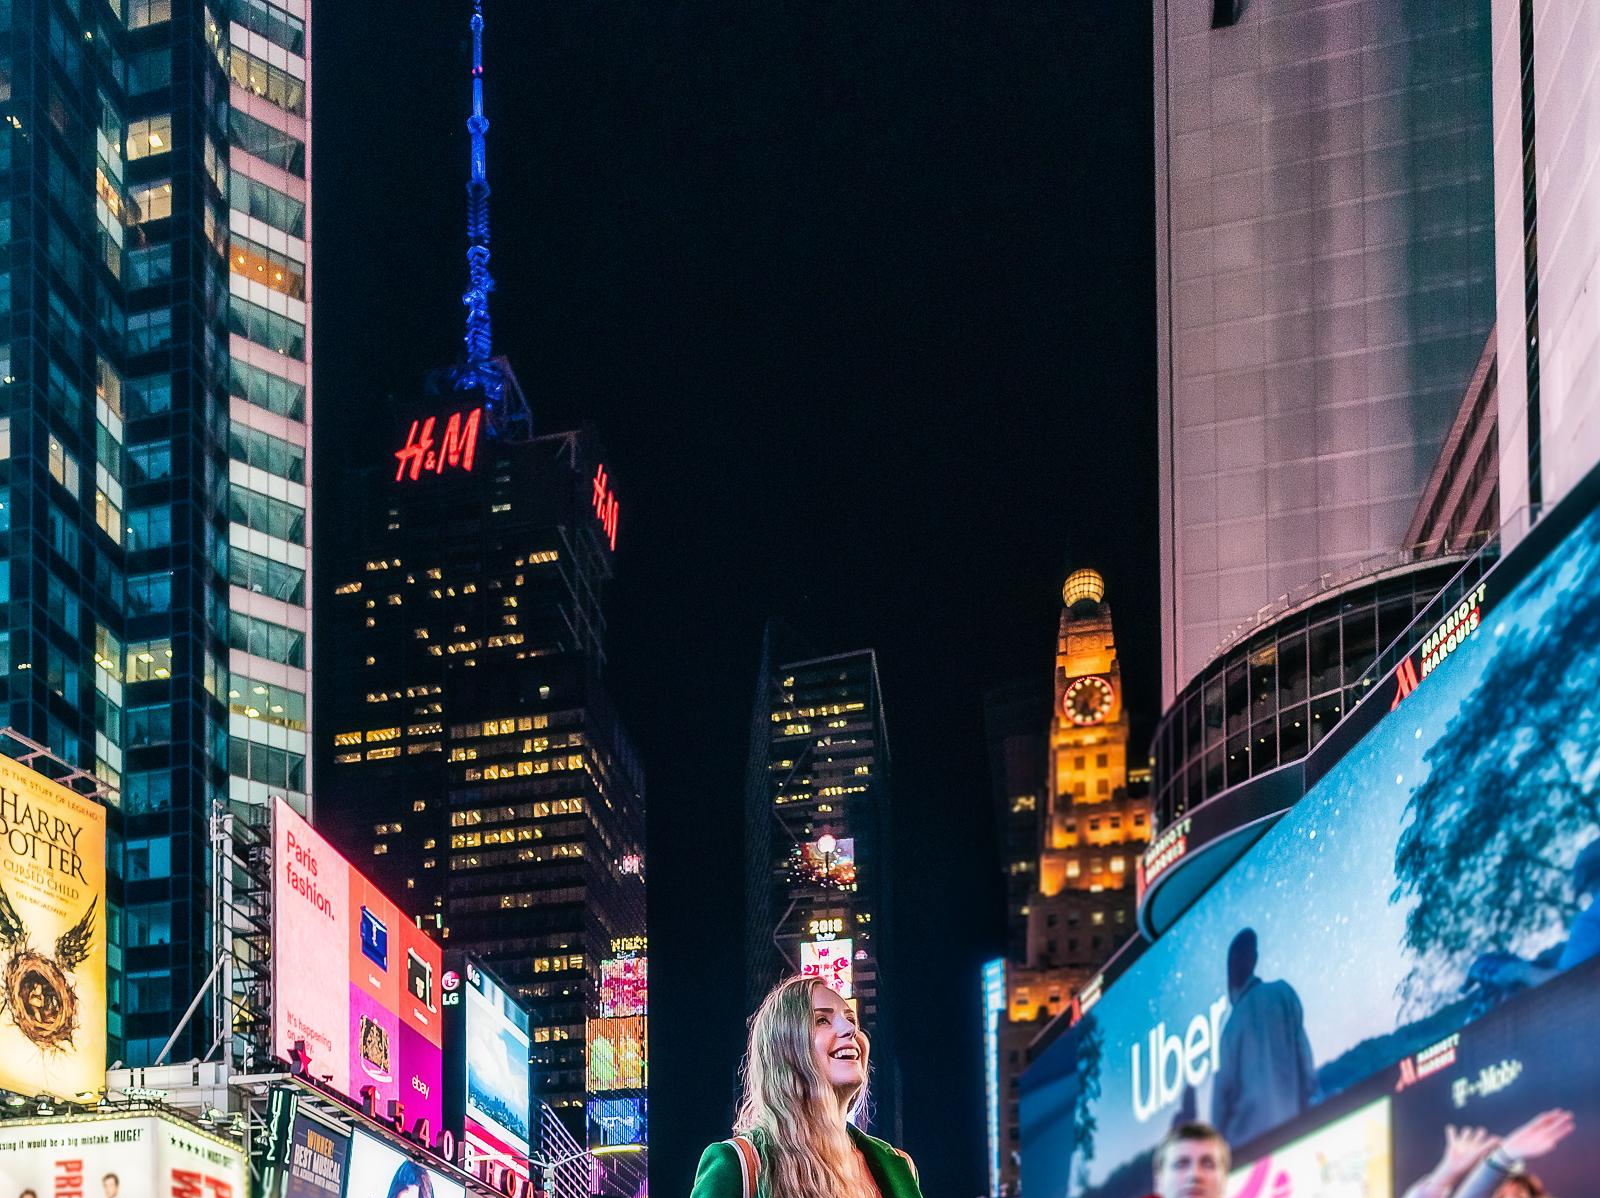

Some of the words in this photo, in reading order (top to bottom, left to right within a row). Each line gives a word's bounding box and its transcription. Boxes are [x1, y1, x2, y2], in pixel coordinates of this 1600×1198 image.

[395, 407, 481, 482] H&M
[1421, 583, 1486, 659] MARRIOTT
[1421, 612, 1479, 678] MARQUIS
[0, 786, 82, 853] HARRY
[3, 858, 45, 885] CURSED
[47, 877, 79, 900] CHILD
[286, 830, 318, 877] Paris
[286, 861, 335, 921] fashion.
[442, 992, 460, 1006] LG
[1131, 995, 1228, 1123] Uber
[412, 1074, 430, 1100] ebay
[27, 1138, 47, 1149] would
[50, 1137, 58, 1147] be
[294, 1143, 313, 1170] BEST
[311, 1150, 341, 1184] MUSICAL
